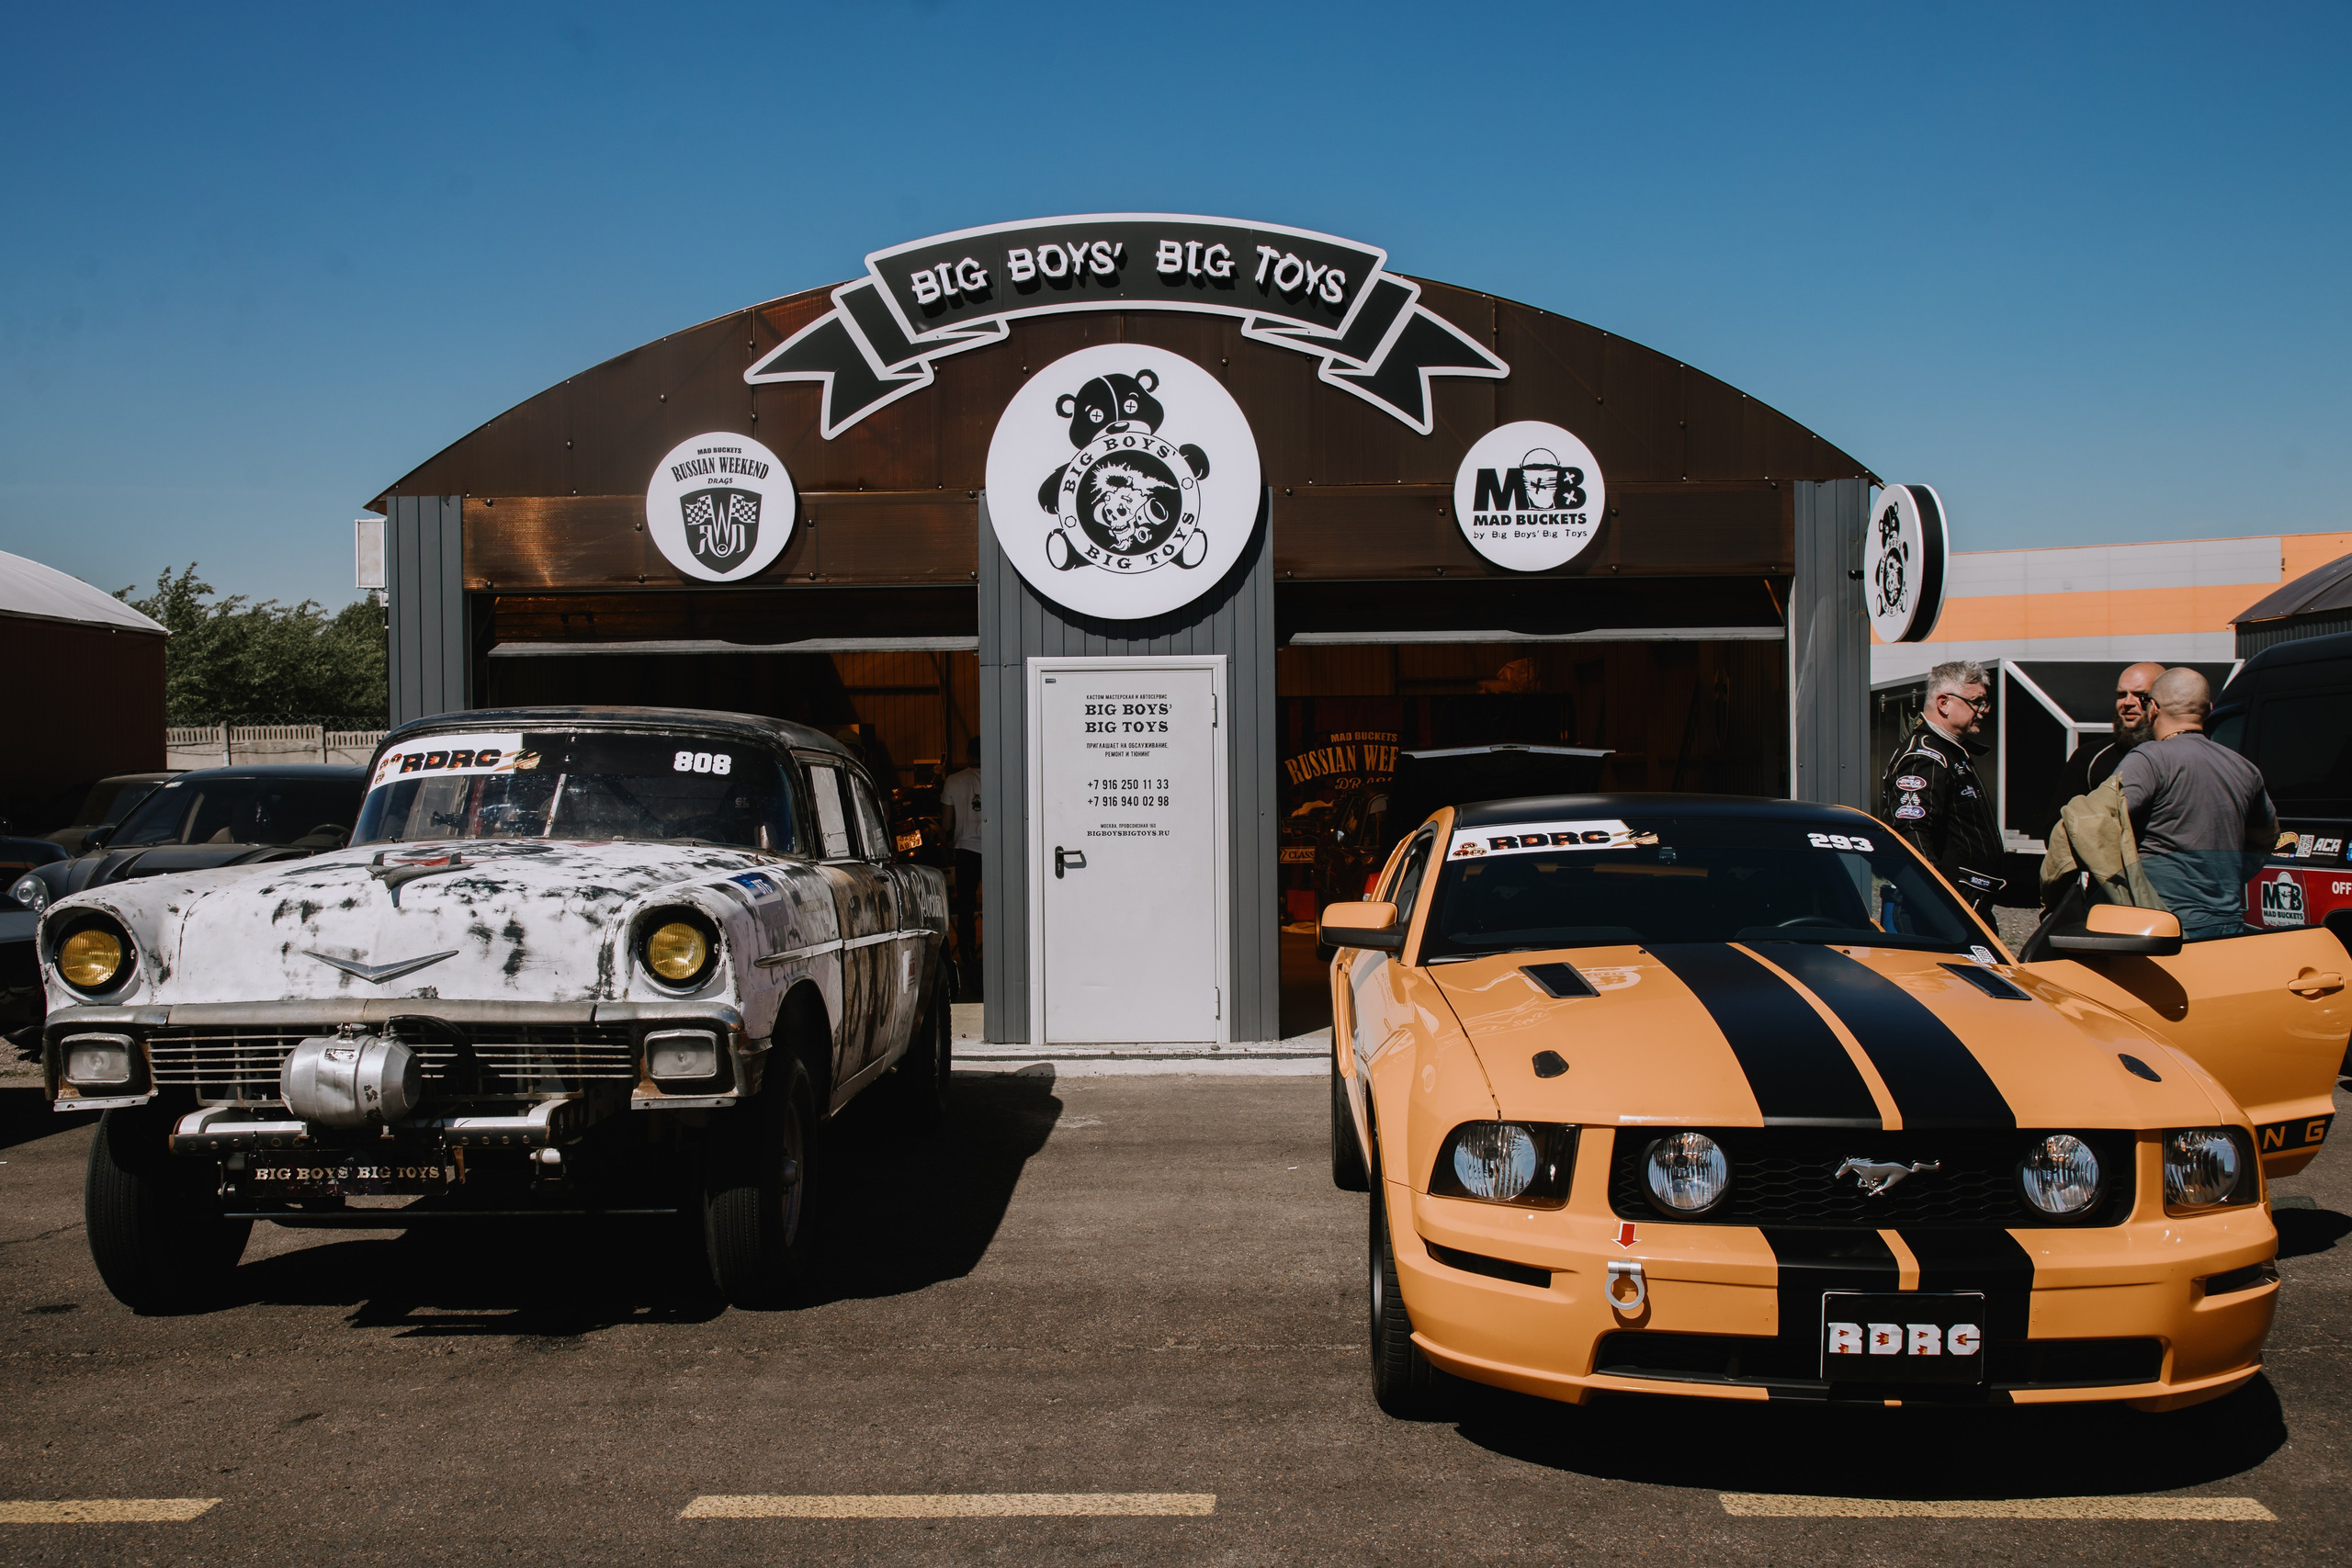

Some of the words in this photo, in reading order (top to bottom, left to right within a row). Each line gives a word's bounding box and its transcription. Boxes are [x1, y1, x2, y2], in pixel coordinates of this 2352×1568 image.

[910, 257, 988, 305] BIG
[1155, 240, 1236, 276] BIG
[1254, 245, 1347, 303] TOYS
[671, 457, 716, 482] RUSSIAN
[719, 457, 769, 479] WEEKEND
[1063, 452, 1093, 494] BIG
[1473, 514, 1512, 526] MAD
[1516, 513, 1588, 525] BUCKETS
[1084, 544, 1132, 570] BIG
[1147, 512, 1194, 565] TOYS
[1474, 531, 1485, 539] by
[1491, 531, 1507, 539] Big
[1543, 530, 1558, 538] Big
[1565, 529, 1588, 537] Toys
[1085, 704, 1117, 716] BIG
[1085, 721, 1117, 733] BIG
[1122, 720, 1169, 733] TOYS
[1331, 732, 1352, 743] MAD
[1354, 731, 1397, 742] BUCKETS
[399, 749, 503, 774] RDRC
[673, 750, 732, 775] 808
[1284, 745, 1356, 785] RUSSIAN
[1088, 780, 1099, 790] +7
[1102, 780, 1117, 790] 916
[1121, 779, 1138, 790] 250
[1143, 779, 1151, 789] 11
[1157, 779, 1169, 790] 33
[1088, 796, 1099, 807] +7
[1102, 796, 1117, 807] 916
[1121, 796, 1138, 807] 940
[1143, 796, 1154, 807] 02
[1158, 796, 1169, 807] 98
[1487, 830, 1611, 851] RDRC
[1806, 832, 1874, 852] 293
[2312, 838, 2342, 852] ACR
[2332, 881, 2352, 895] OFF
[2264, 909, 2277, 918] MAD
[2278, 911, 2304, 920] BUCKETS
[254, 1168, 291, 1180] BIG
[357, 1166, 391, 1179] BIG
[397, 1167, 440, 1179] TOYS
[1828, 1323, 1981, 1356] RDRC
